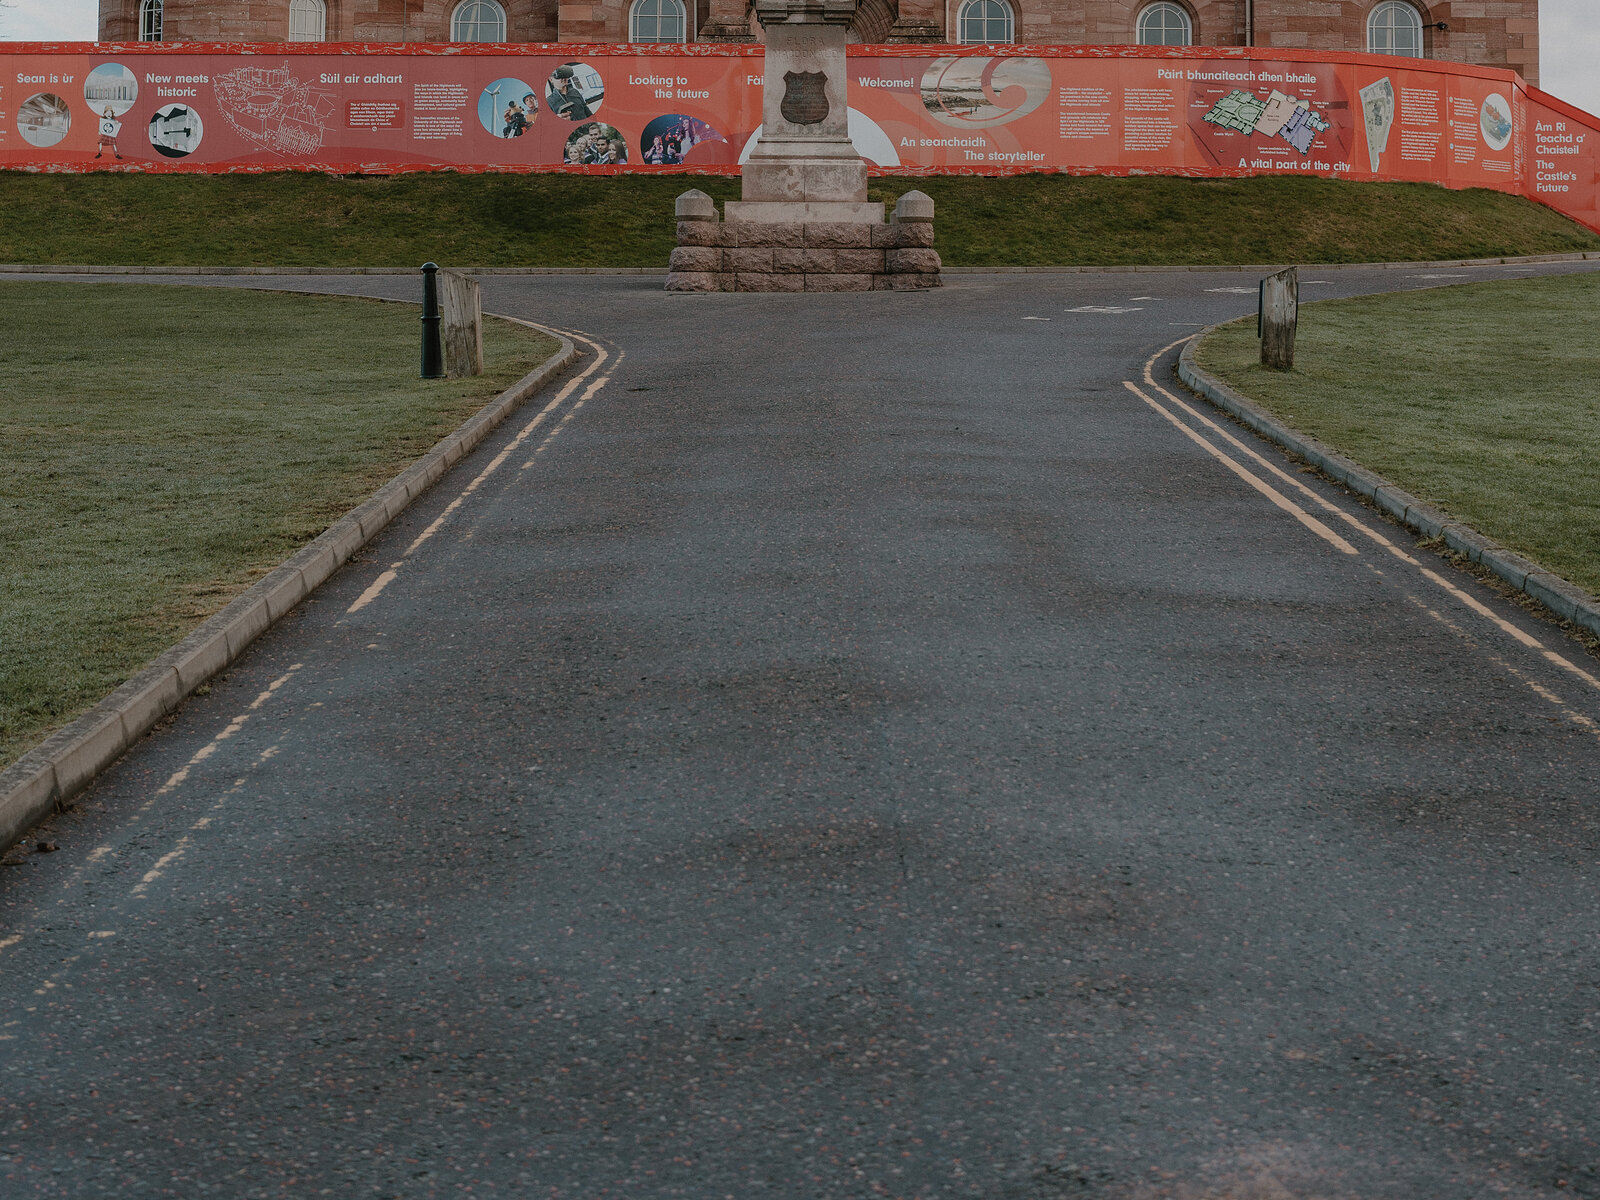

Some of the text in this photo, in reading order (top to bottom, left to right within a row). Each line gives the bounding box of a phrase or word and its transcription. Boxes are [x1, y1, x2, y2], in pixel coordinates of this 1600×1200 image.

[16, 72, 75, 84] Sean is ùr
[146, 72, 209, 84] New meets
[319, 72, 403, 84] Sùil air adhart
[629, 74, 688, 88] Looking to
[858, 76, 914, 88] Welcome!
[1157, 68, 1317, 84] Pàirt bhunaiteach dhen bhaile
[157, 86, 197, 97] historic
[654, 88, 710, 99] the future
[1535, 120, 1566, 132] Àm Ri
[900, 136, 986, 147] An seanchaidh
[1535, 133, 1573, 143] Teachd
[1535, 144, 1580, 155] Chaisteil
[963, 150, 1046, 163] The storyteller
[1238, 158, 1352, 174] A vital part of the city
[1535, 159, 1555, 169] The
[1536, 182, 1569, 192] Future
